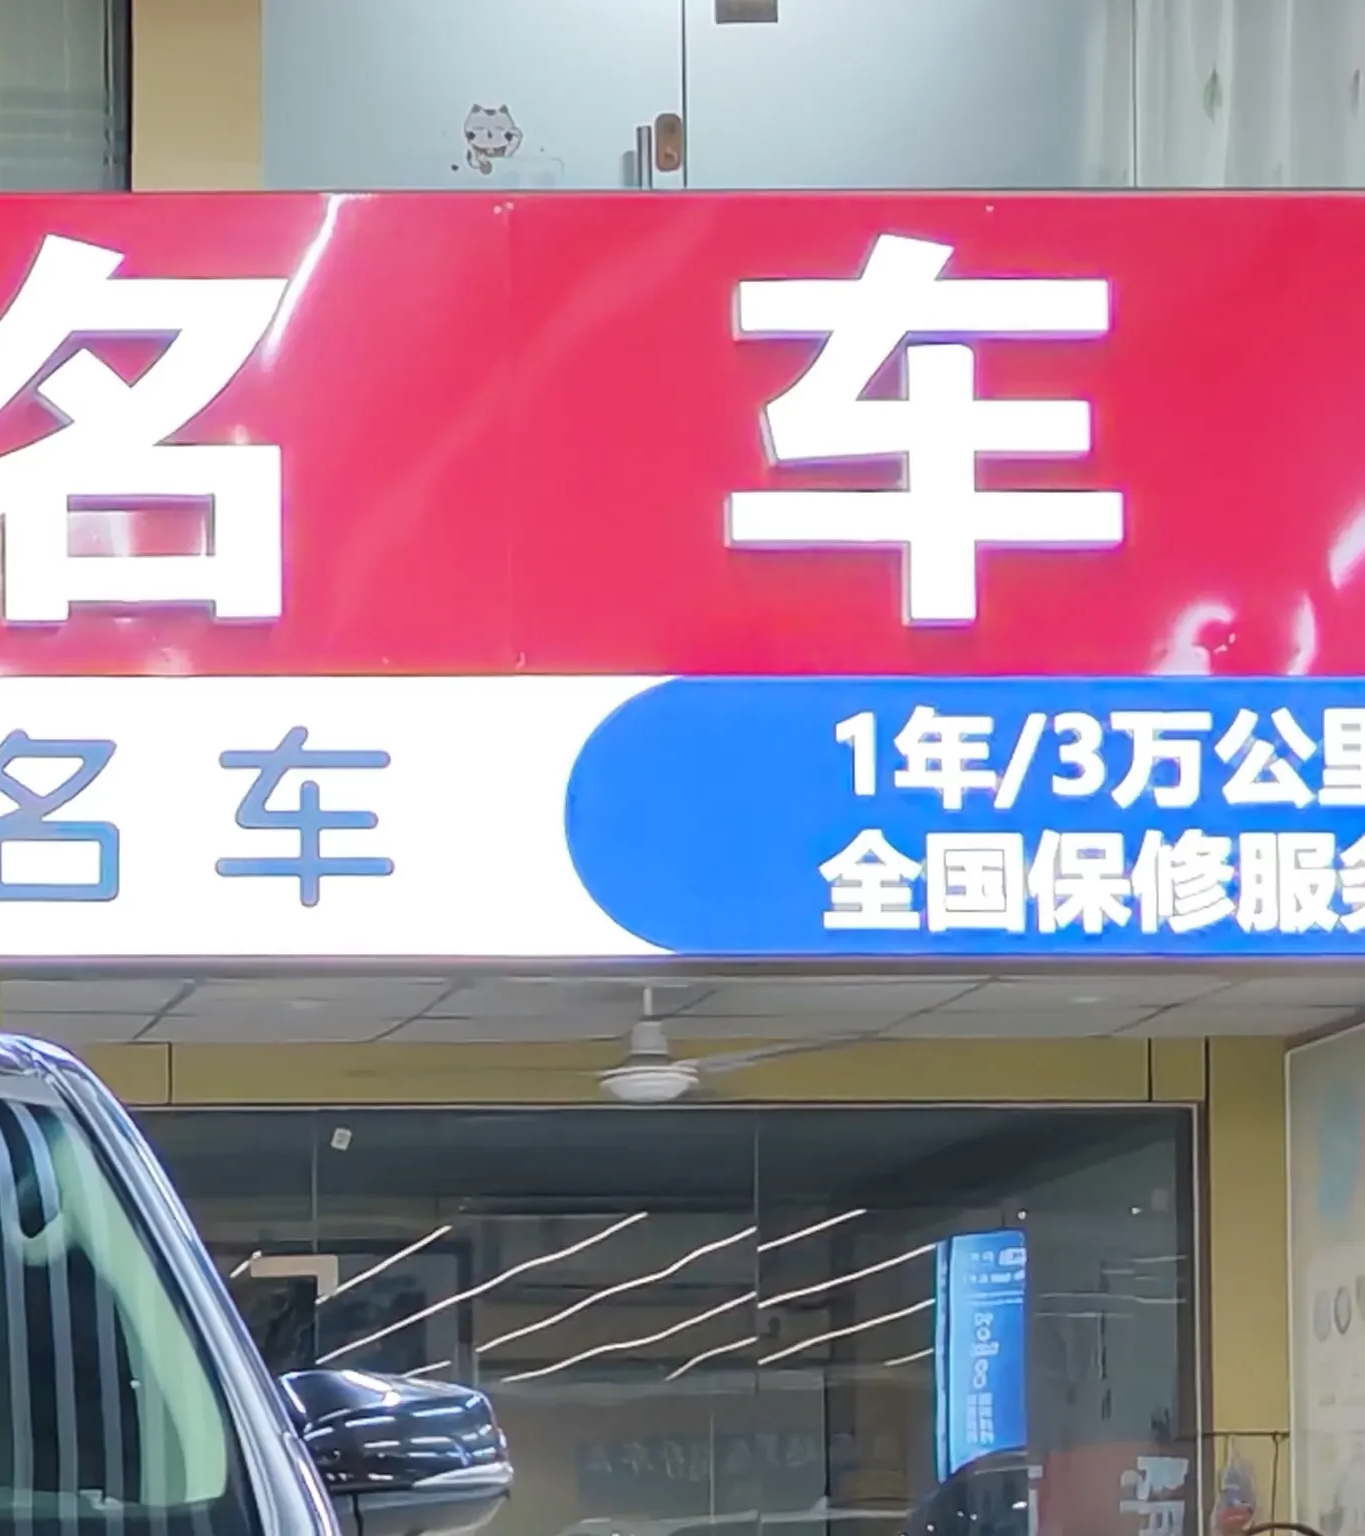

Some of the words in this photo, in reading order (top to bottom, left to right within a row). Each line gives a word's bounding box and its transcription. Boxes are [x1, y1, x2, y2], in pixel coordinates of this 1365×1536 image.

[819, 829, 1365, 934] 全国保修服
